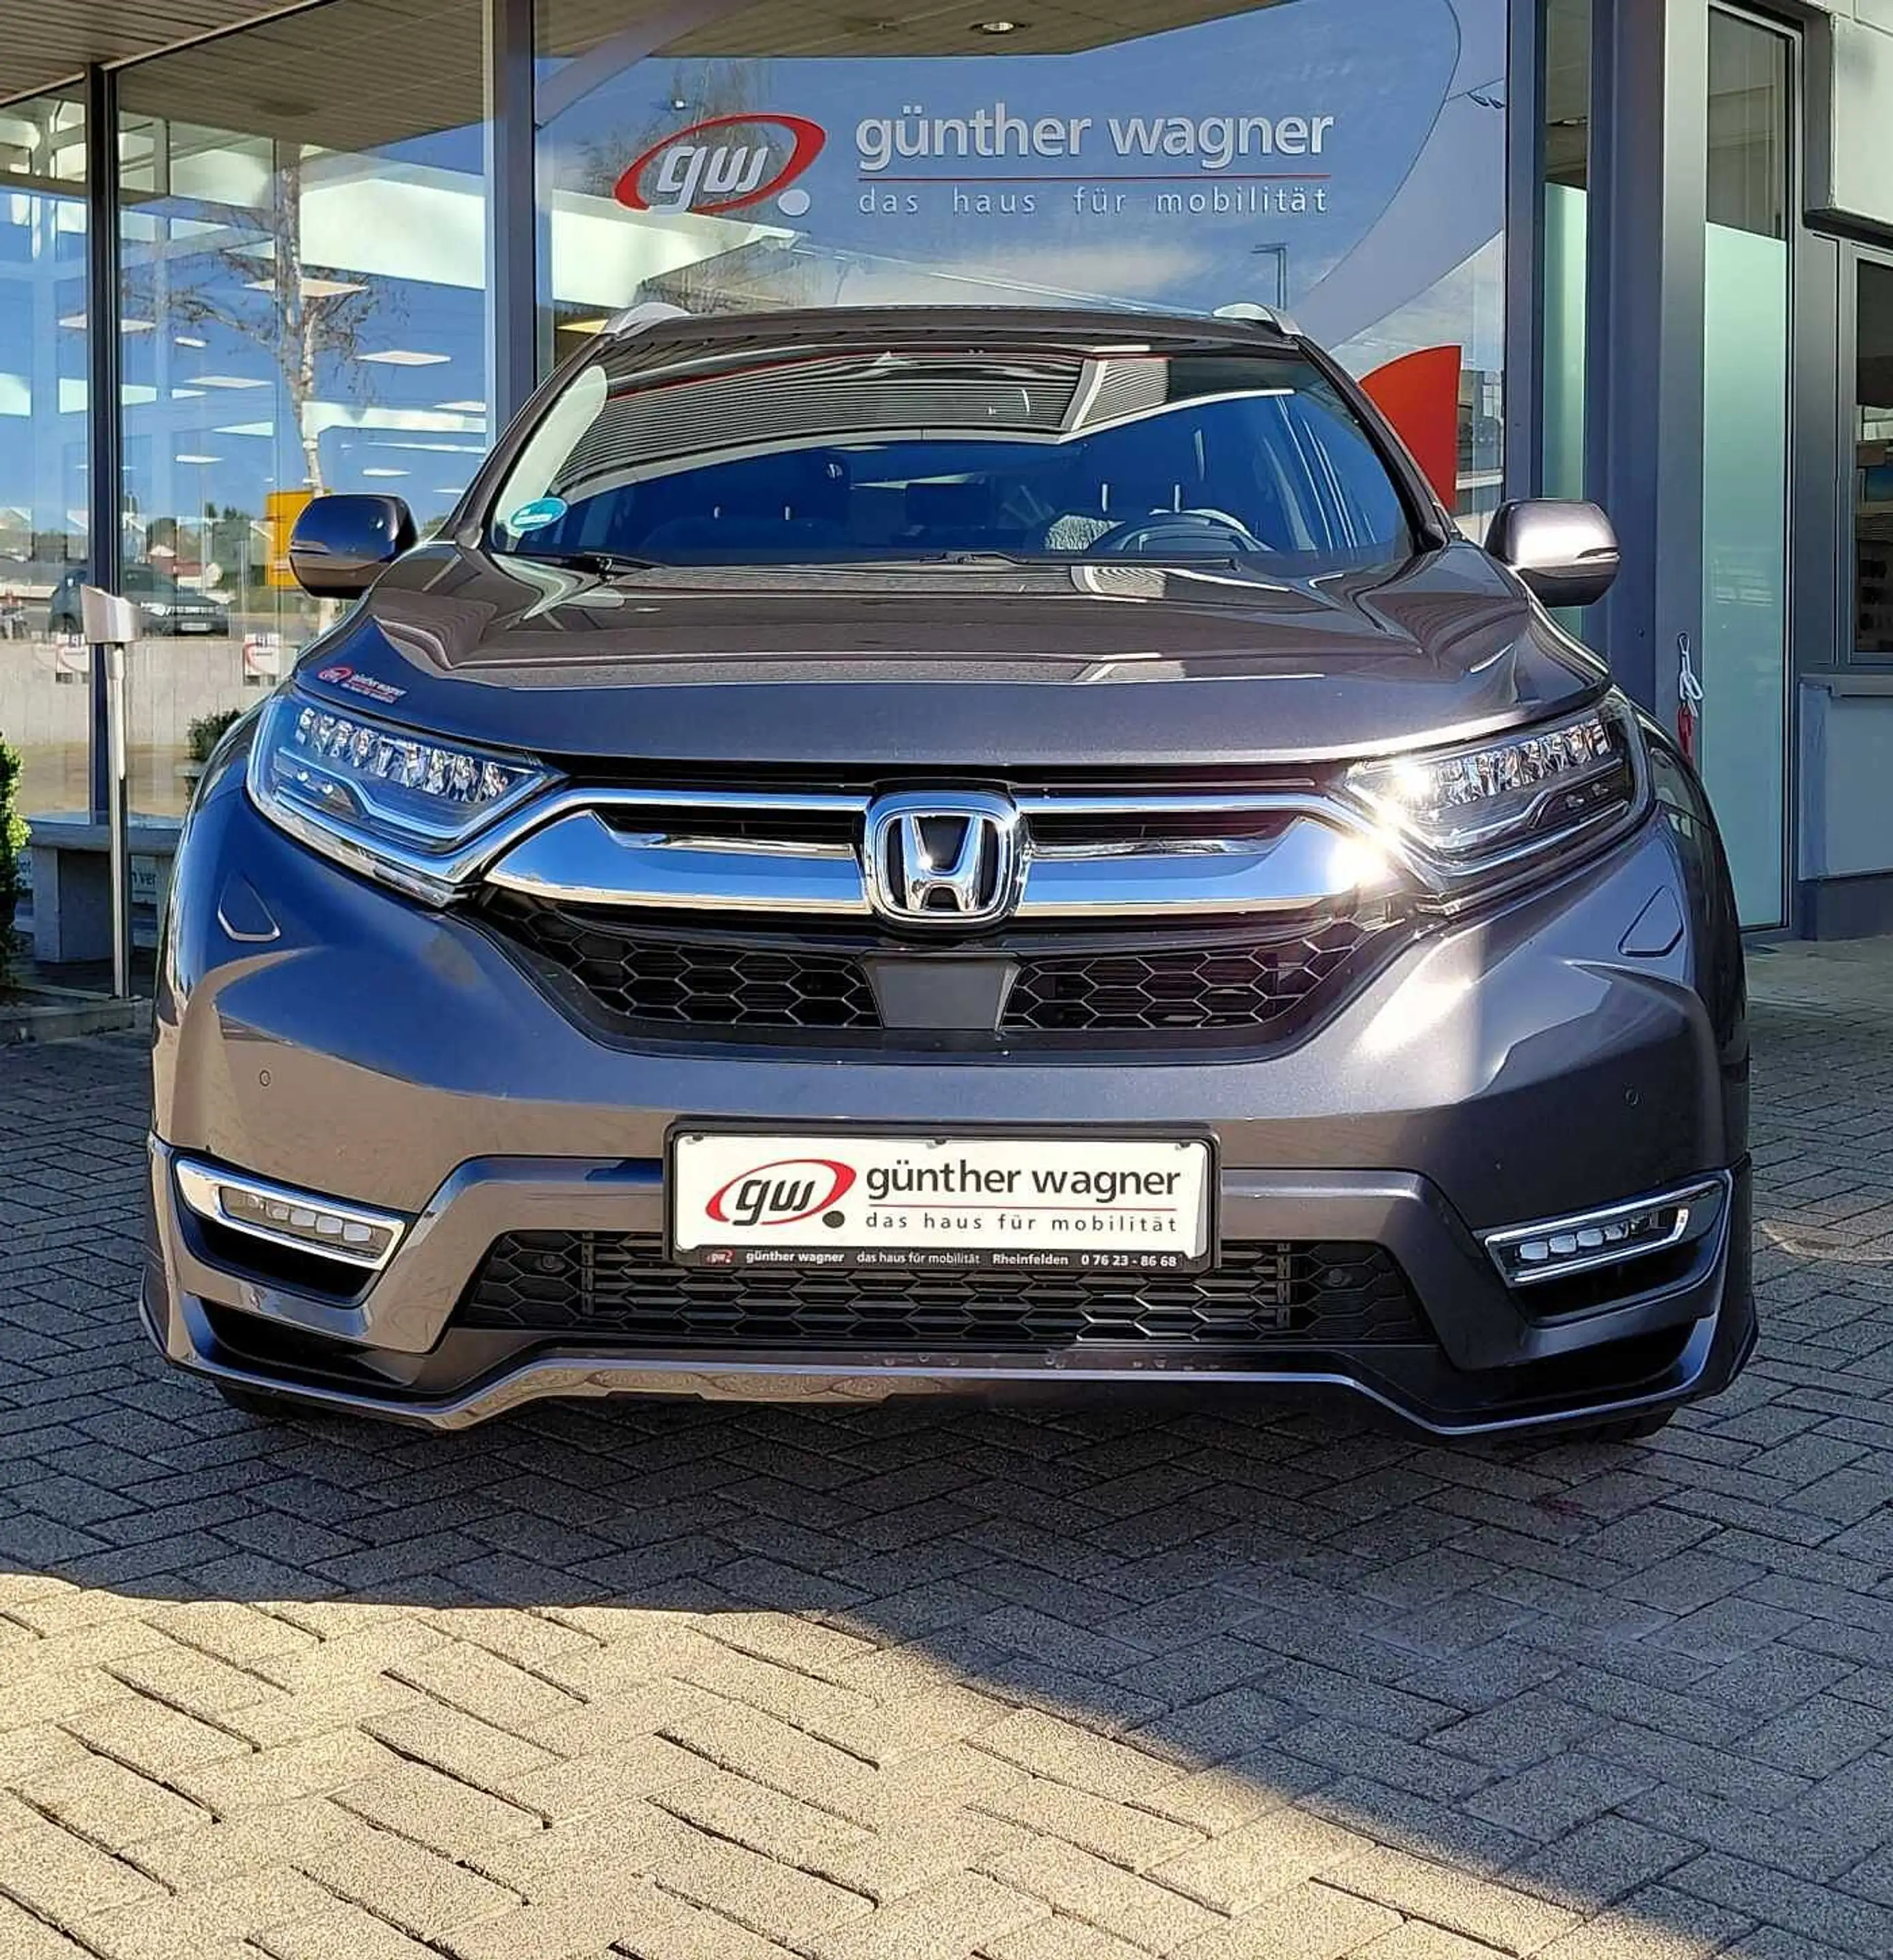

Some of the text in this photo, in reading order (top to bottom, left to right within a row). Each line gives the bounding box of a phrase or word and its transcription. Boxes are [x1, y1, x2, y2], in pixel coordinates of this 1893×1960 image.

[855, 102, 1334, 171] günther wagner
[859, 184, 1327, 214] das haus für mobilität
[866, 1159, 1181, 1203] günther wagner
[866, 1211, 1176, 1232] das haus für mobilität
[746, 1250, 794, 1264] günther
[798, 1253, 844, 1264] wagner
[857, 1252, 876, 1262] das
[879, 1252, 906, 1263] haus
[908, 1251, 925, 1264] für
[928, 1252, 980, 1264] mobilität
[992, 1254, 1069, 1266] Rheinfelden
